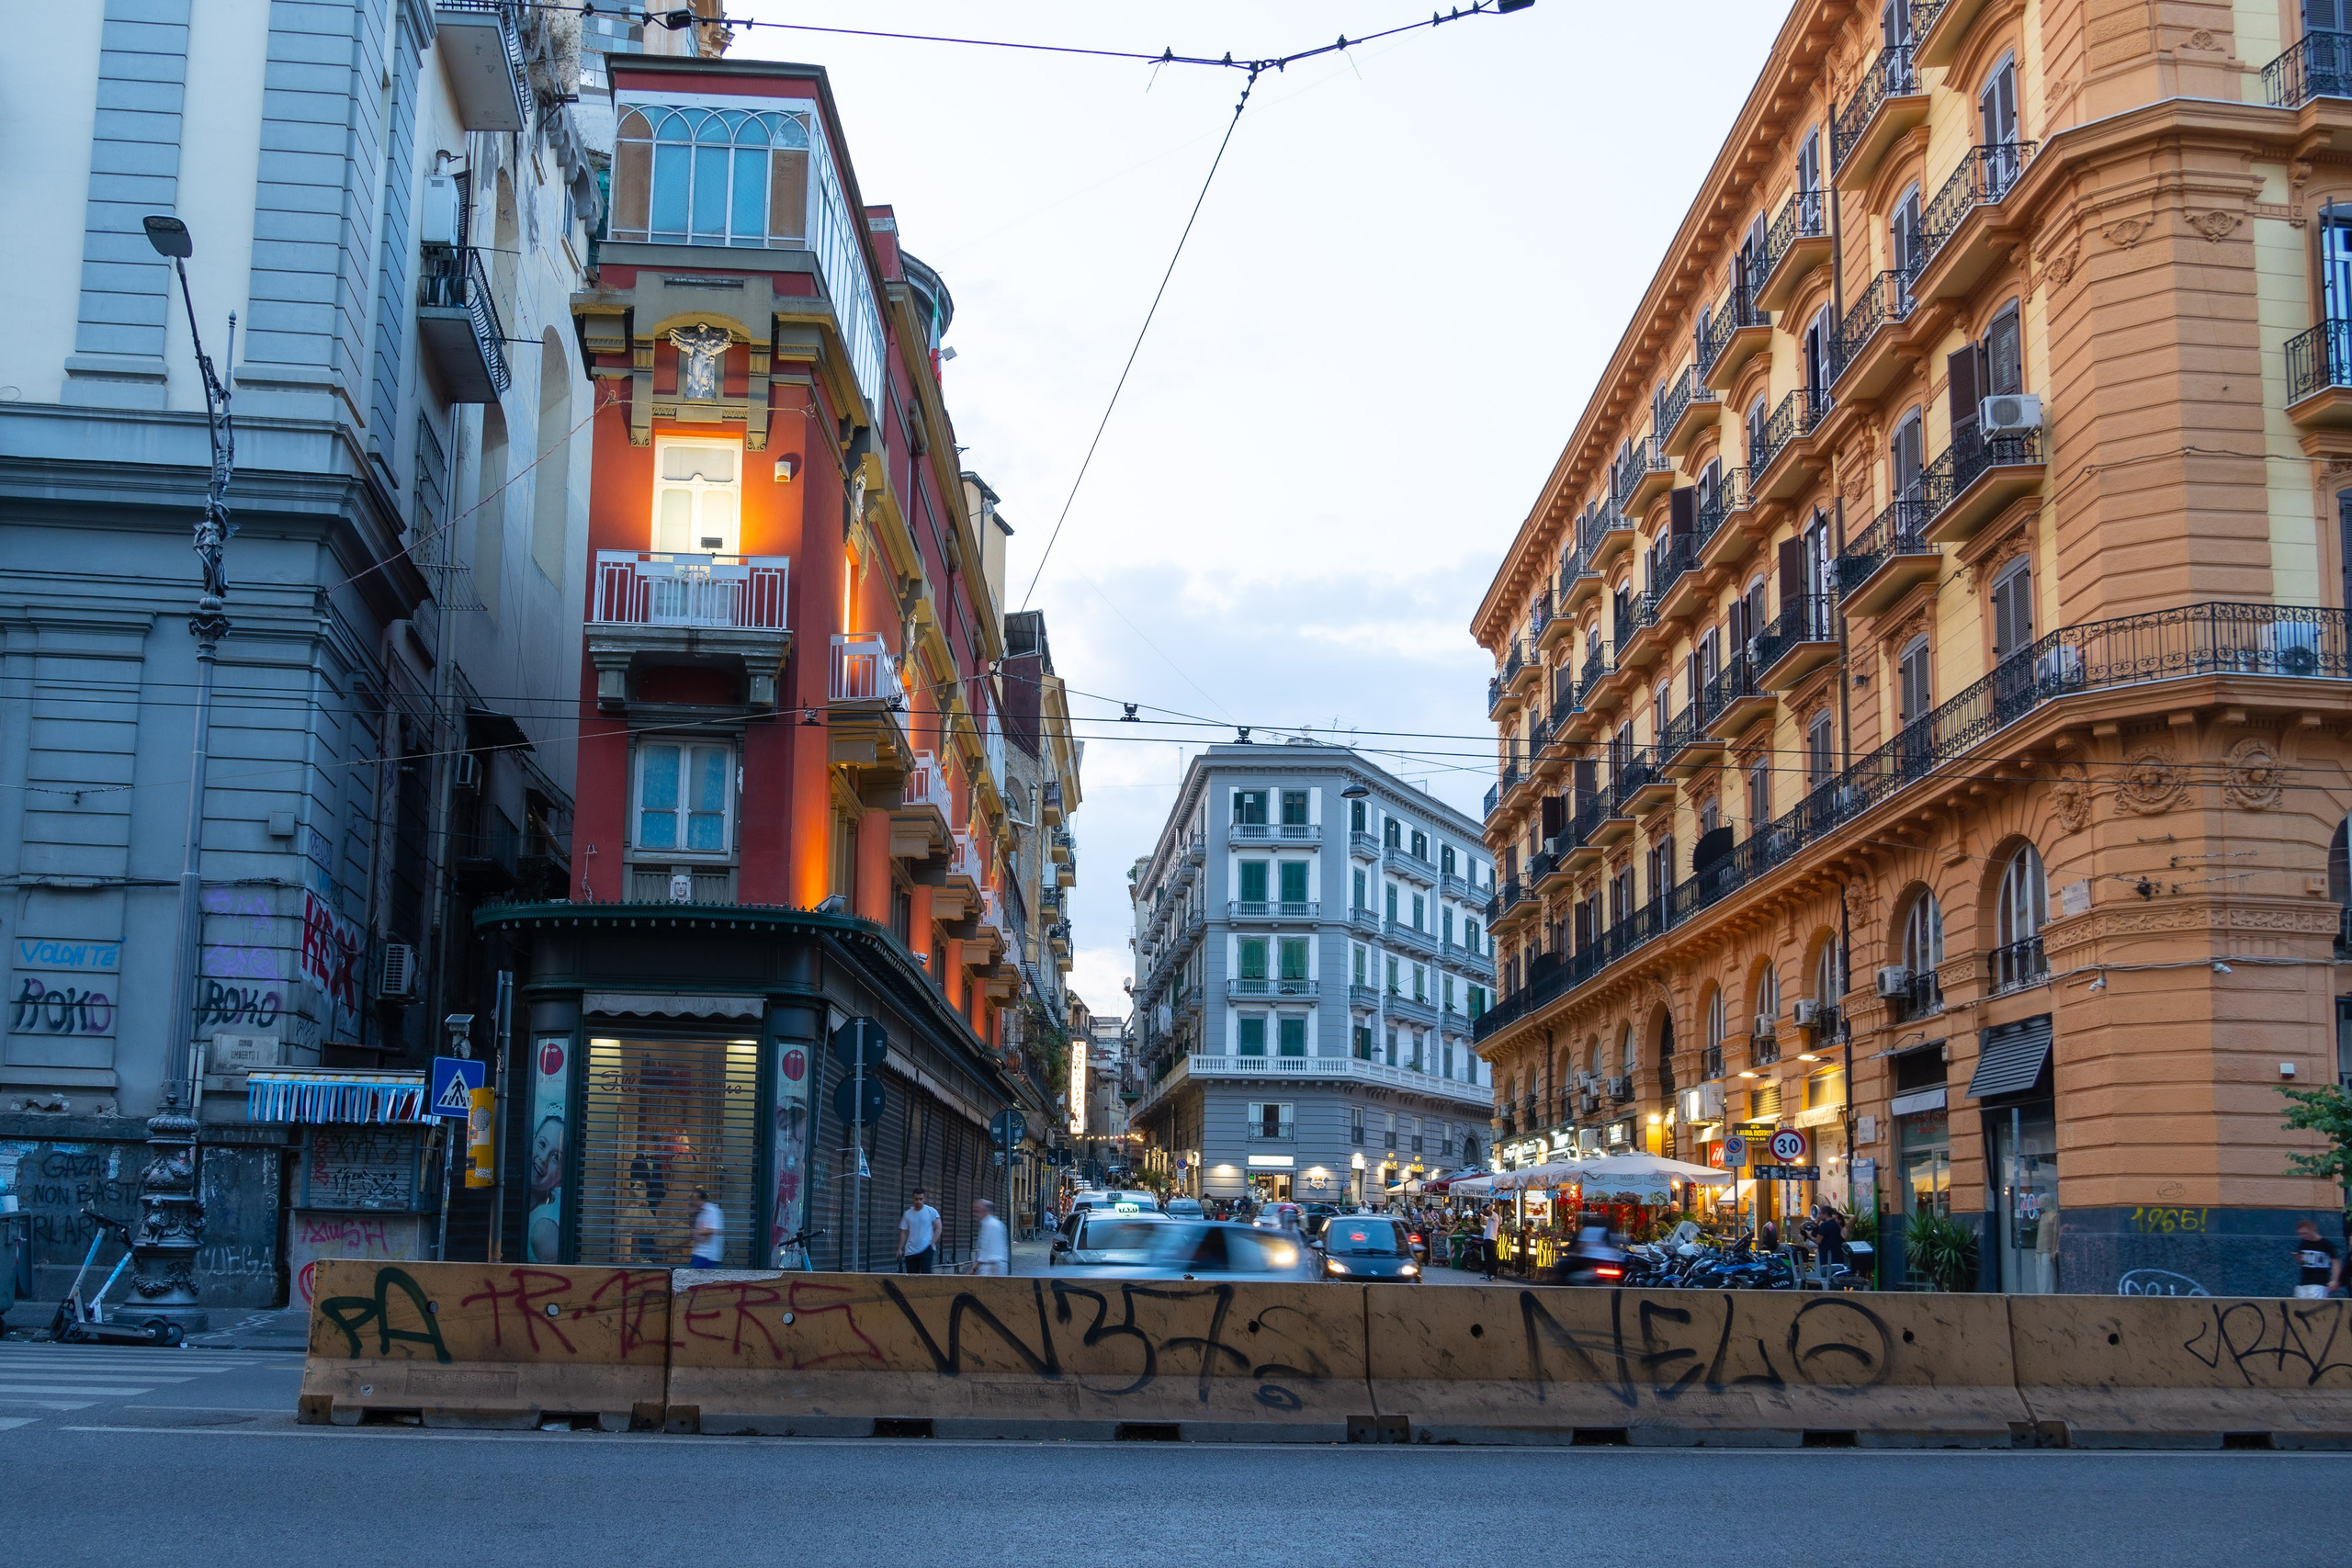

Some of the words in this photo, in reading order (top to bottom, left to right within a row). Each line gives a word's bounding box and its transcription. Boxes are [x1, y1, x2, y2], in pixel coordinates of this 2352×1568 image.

[231, 1051, 255, 1060] UMBERTO
[1712, 1147, 1724, 1161] ill
[1778, 1138, 1799, 1154] 30
[42, 1154, 107, 1179] GAZA:
[33, 1184, 69, 1205] NON
